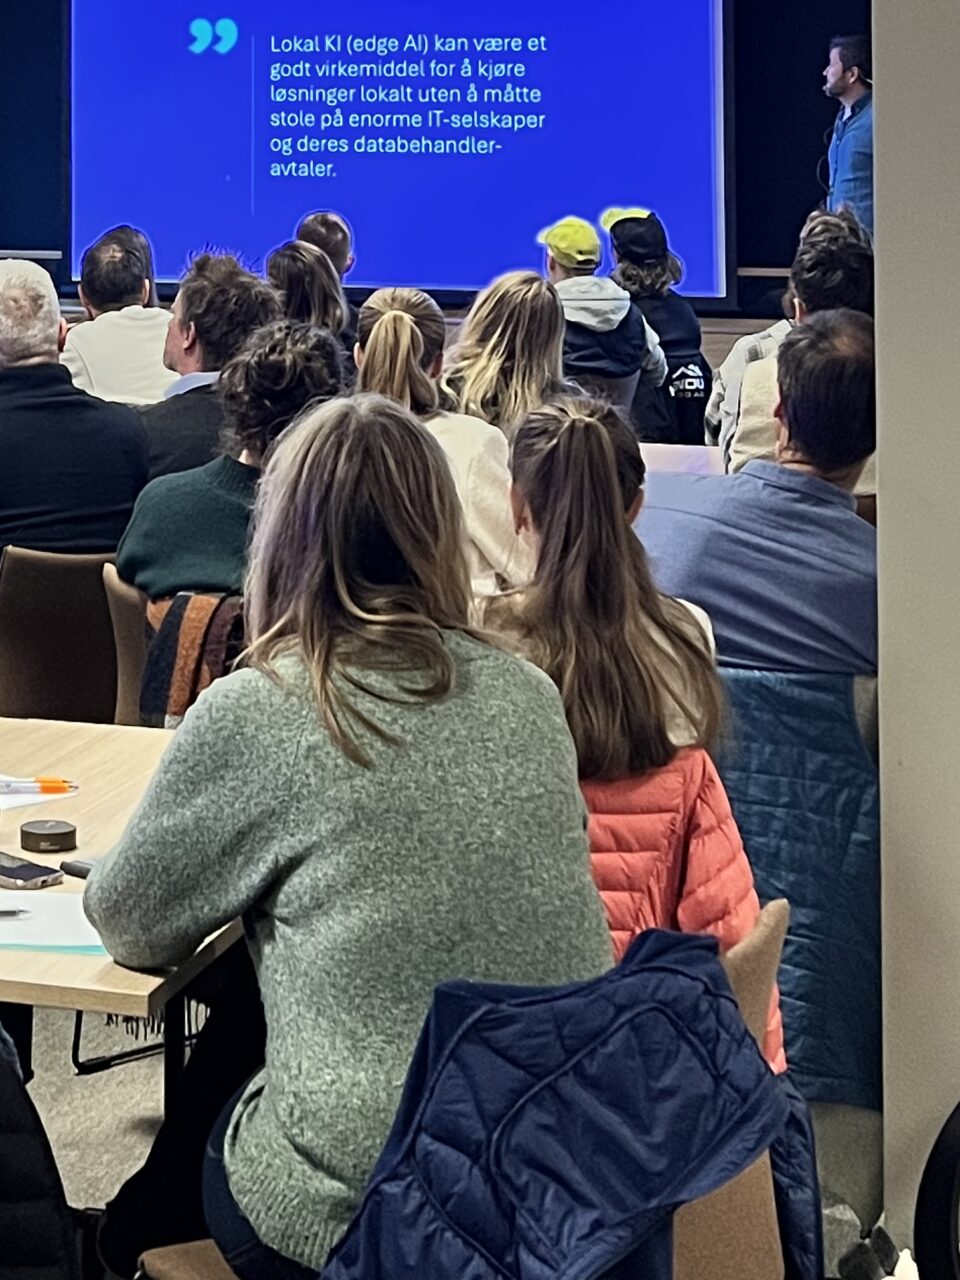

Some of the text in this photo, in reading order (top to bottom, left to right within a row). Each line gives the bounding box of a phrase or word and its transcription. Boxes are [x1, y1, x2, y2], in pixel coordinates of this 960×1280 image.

[271, 34, 547, 56] Lokal KI (edge AI) kan være et
[270, 58, 525, 81] godt virkemiddel for å kjøre
[271, 83, 541, 106] løsninger lokalt uten å måtte
[270, 108, 546, 132] stole på enorme IT-selskaper
[270, 135, 502, 156] og deres databehandler-
[270, 160, 336, 177] avtaler.
